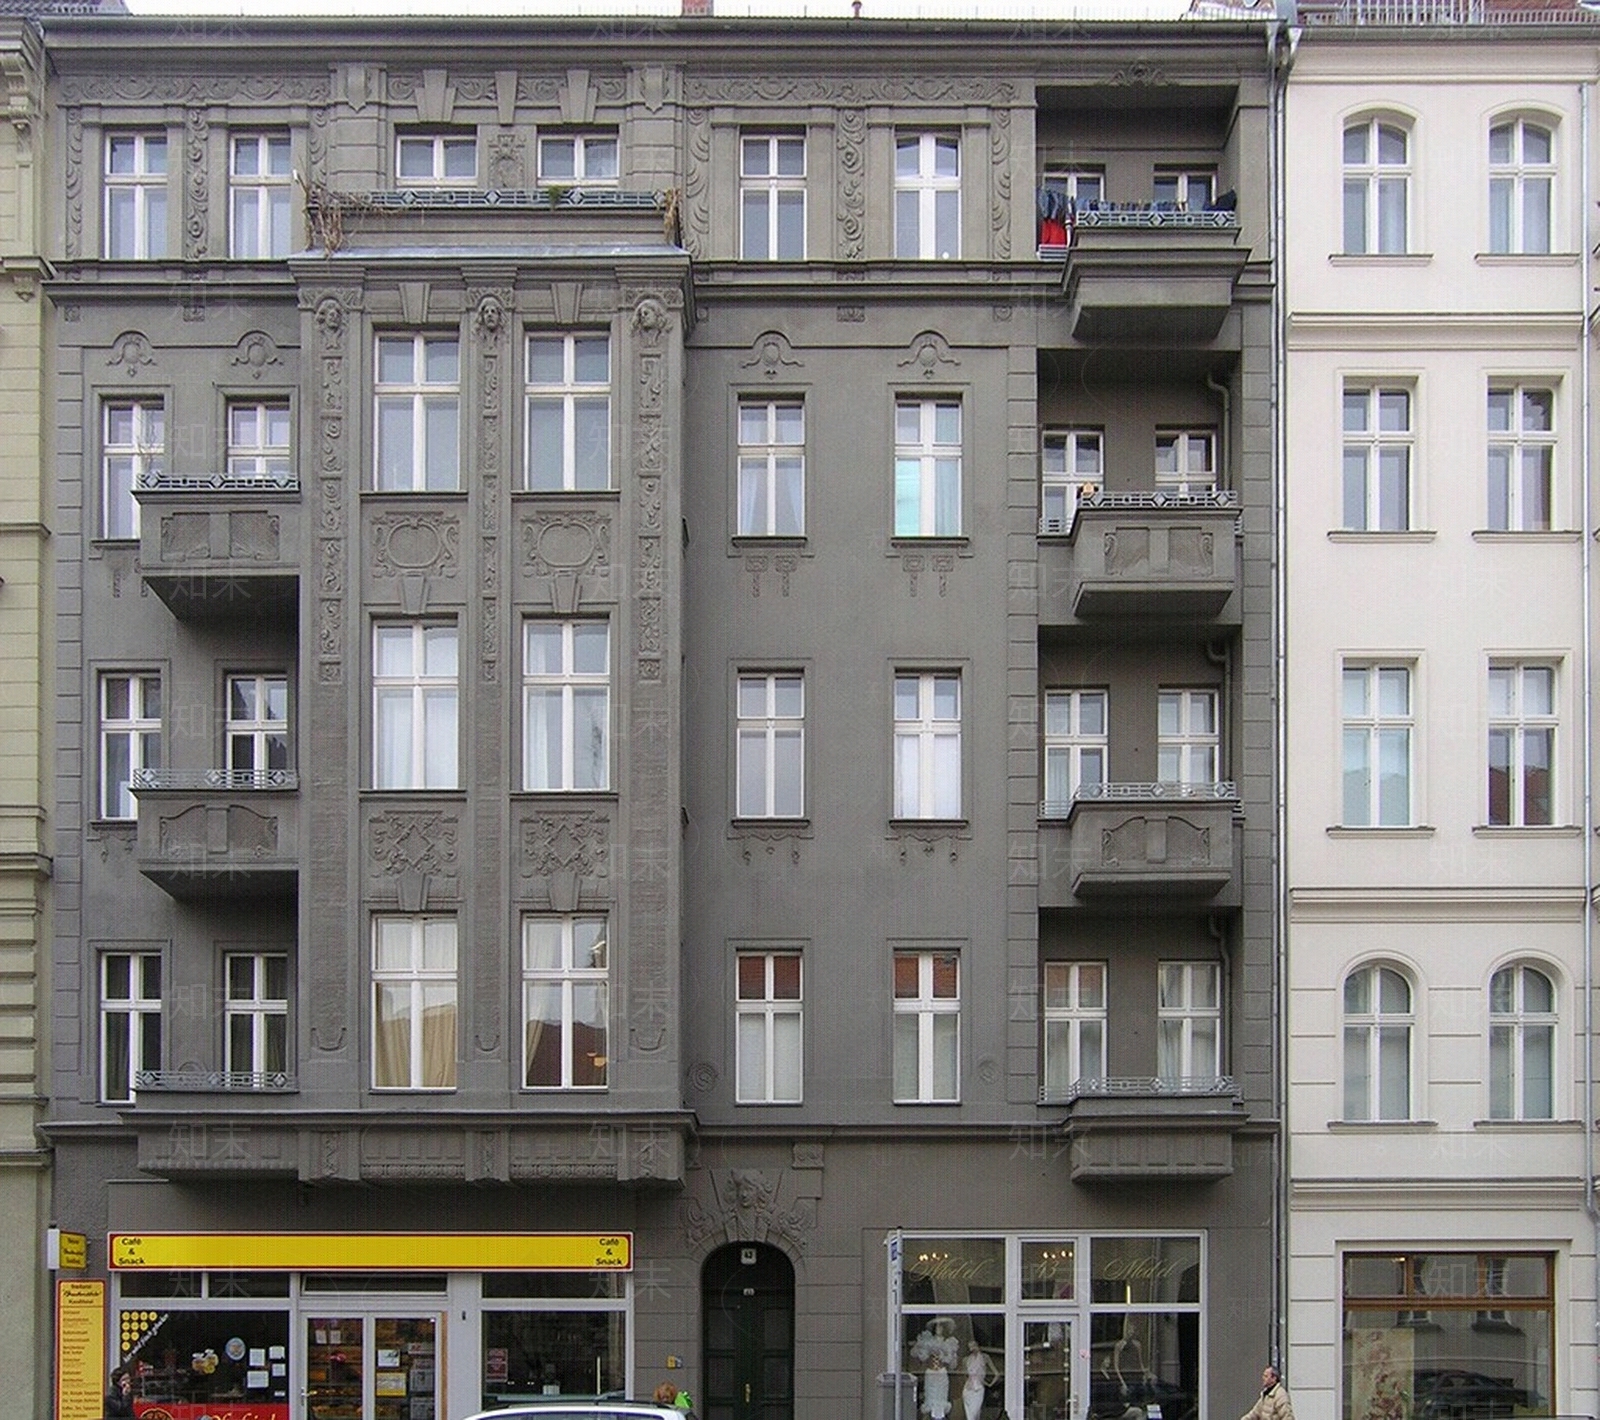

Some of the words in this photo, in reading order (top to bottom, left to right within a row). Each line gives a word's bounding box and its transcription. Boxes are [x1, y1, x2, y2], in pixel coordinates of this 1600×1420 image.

[121, 1237, 142, 1246] Café
[599, 1238, 619, 1246] Café
[128, 1247, 135, 1255] &
[605, 1248, 613, 1256] &
[118, 1257, 146, 1265] Snack
[595, 1257, 622, 1265] Snack
